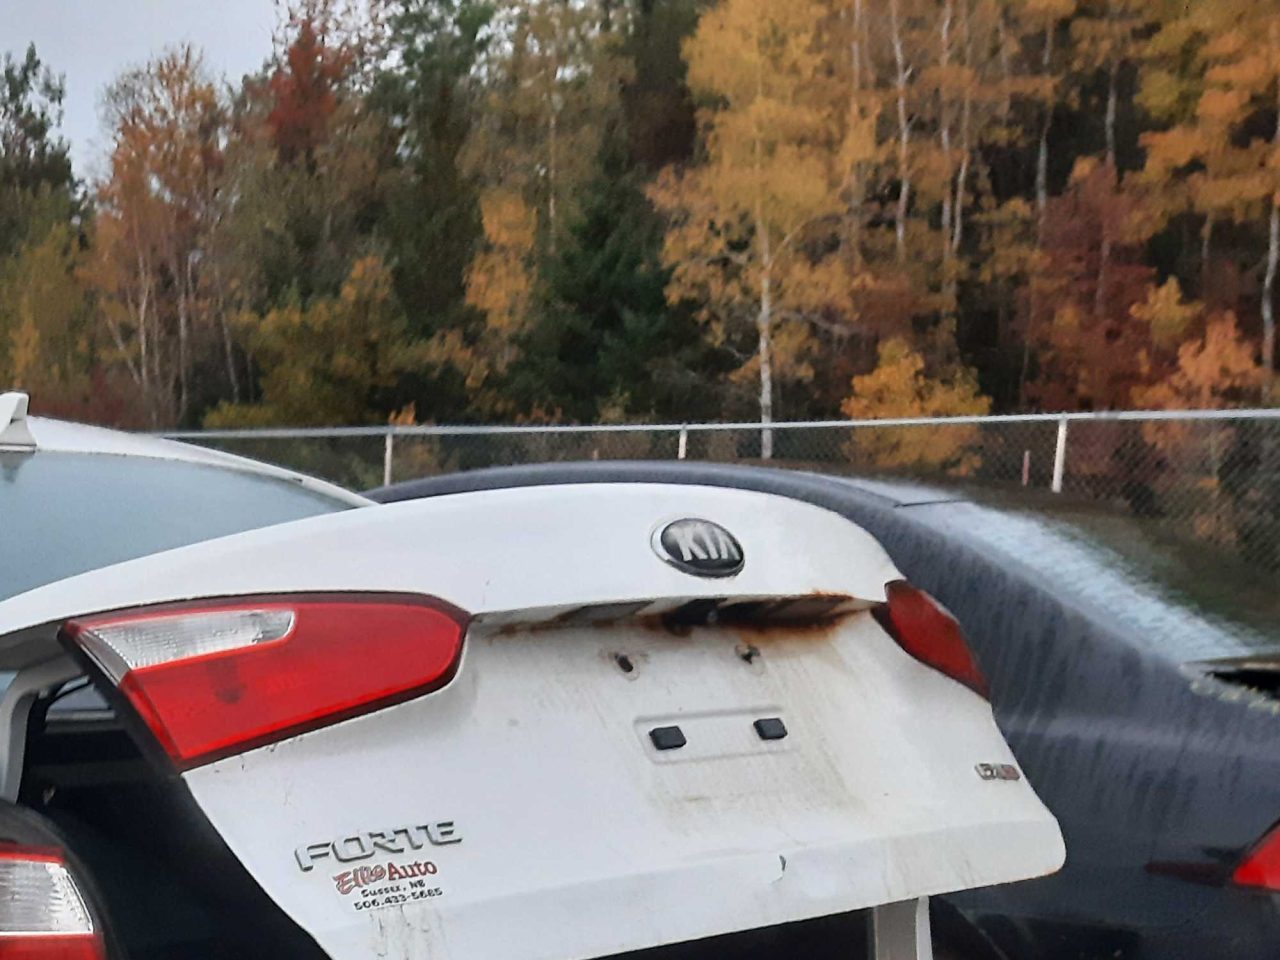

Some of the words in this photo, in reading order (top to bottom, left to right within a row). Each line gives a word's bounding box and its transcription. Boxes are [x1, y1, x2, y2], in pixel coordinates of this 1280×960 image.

[666, 522, 741, 561] KIA
[294, 820, 463, 873] FORTE
[387, 860, 438, 881] Auto
